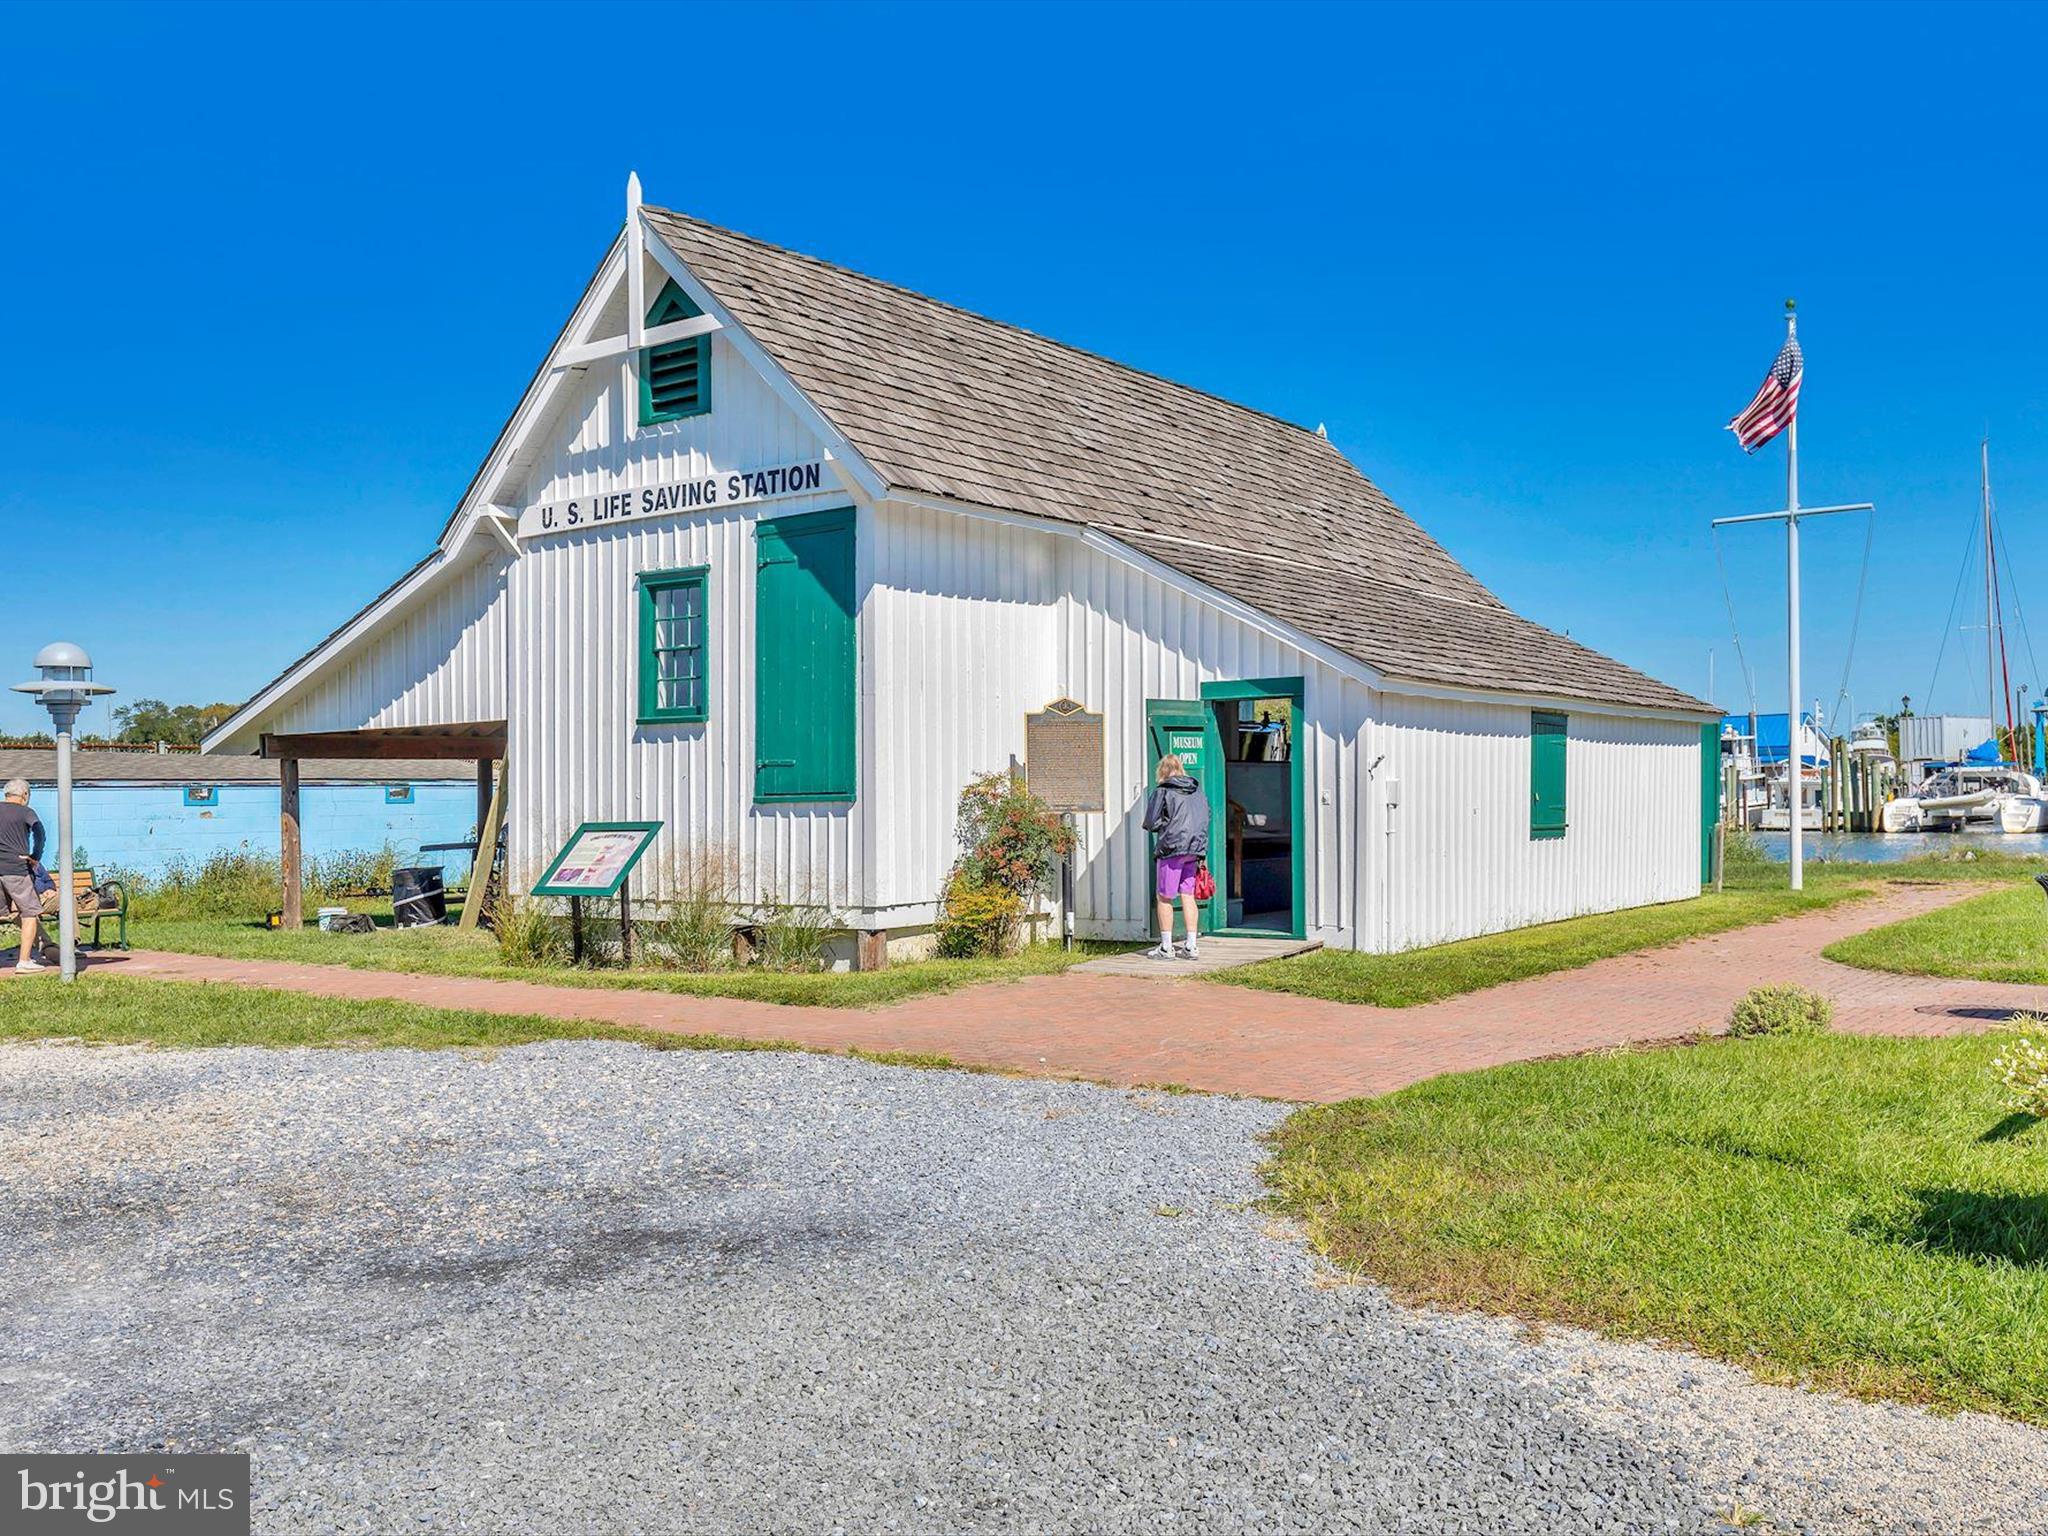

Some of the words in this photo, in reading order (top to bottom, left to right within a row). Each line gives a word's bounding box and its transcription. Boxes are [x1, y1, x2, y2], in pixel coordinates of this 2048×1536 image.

[541, 507, 558, 529] U.
[568, 502, 584, 525] S.
[593, 493, 632, 521] LIFE
[641, 479, 717, 513] SAVING
[727, 463, 821, 501] STATION
[1172, 736, 1203, 749] MUSEUM
[1179, 752, 1198, 765] OPEN
